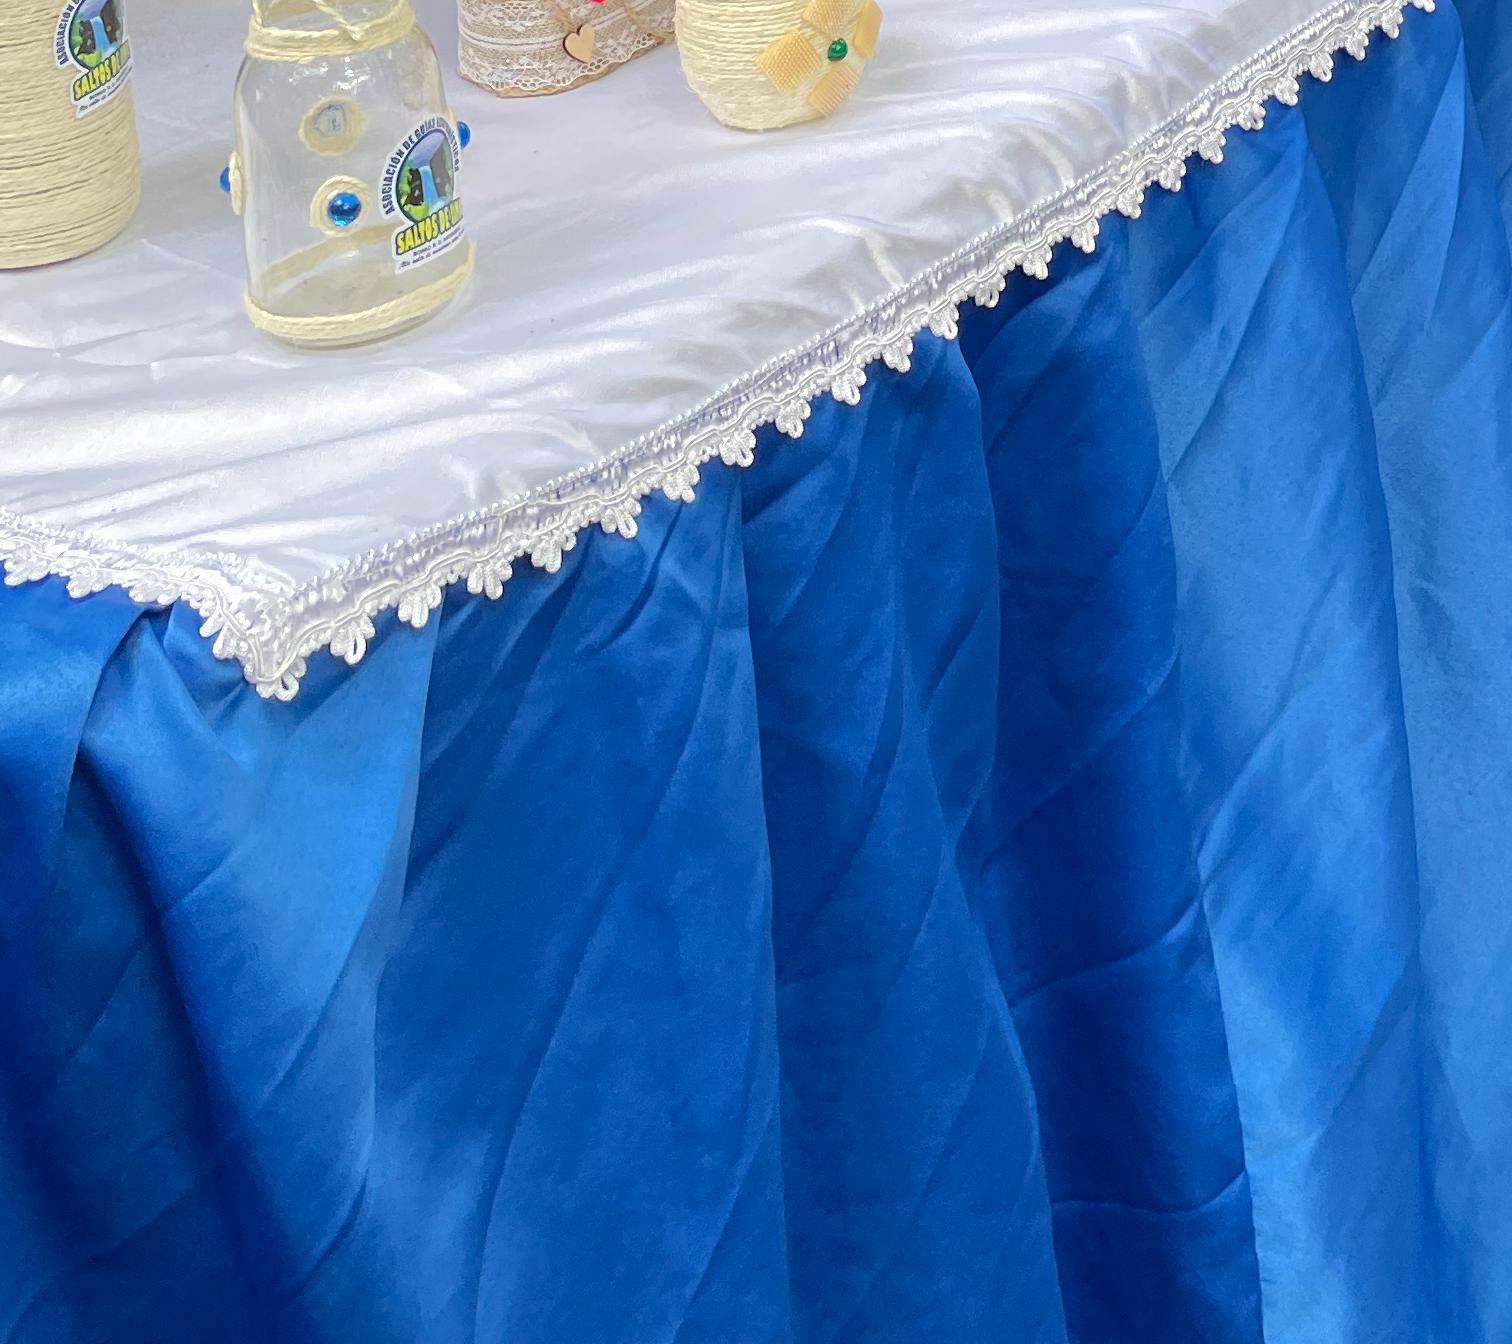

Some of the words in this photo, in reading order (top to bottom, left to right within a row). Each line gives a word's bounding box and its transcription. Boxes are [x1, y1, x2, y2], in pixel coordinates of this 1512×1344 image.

[73, 59, 111, 100] SALTOS
[404, 134, 417, 151] DE
[396, 211, 438, 255] SALTOS
[438, 204, 451, 233] DE
